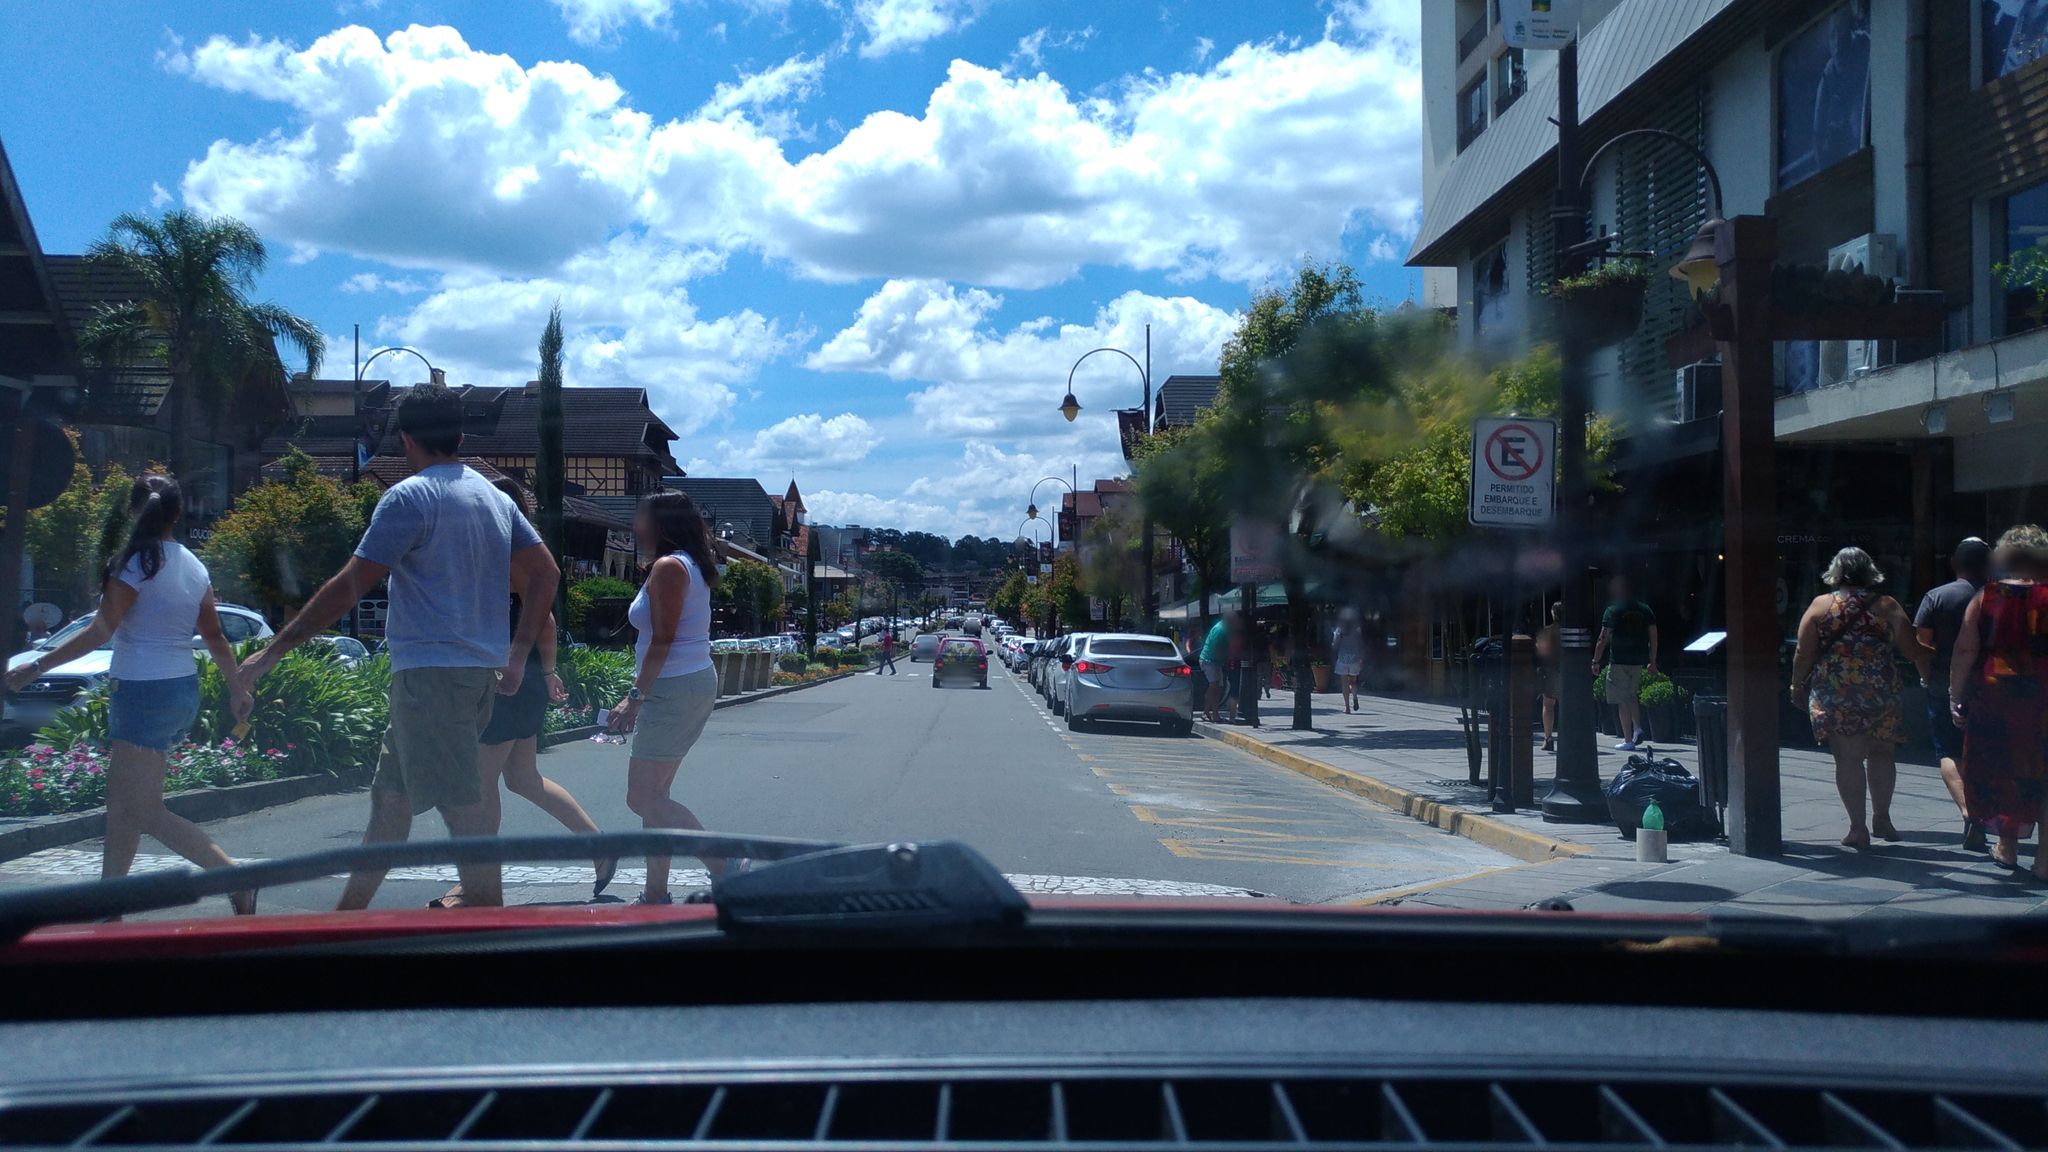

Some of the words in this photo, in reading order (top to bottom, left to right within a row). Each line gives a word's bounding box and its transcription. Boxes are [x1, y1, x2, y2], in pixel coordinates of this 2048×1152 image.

[1502, 437, 1525, 466] E
[1490, 483, 1534, 494] PERMITIDO
[1484, 494, 1531, 505] EMBARQUE
[1532, 497, 1538, 506] E
[1480, 505, 1543, 517] DESEMBARQUE
[1777, 535, 1816, 544] CREMA
